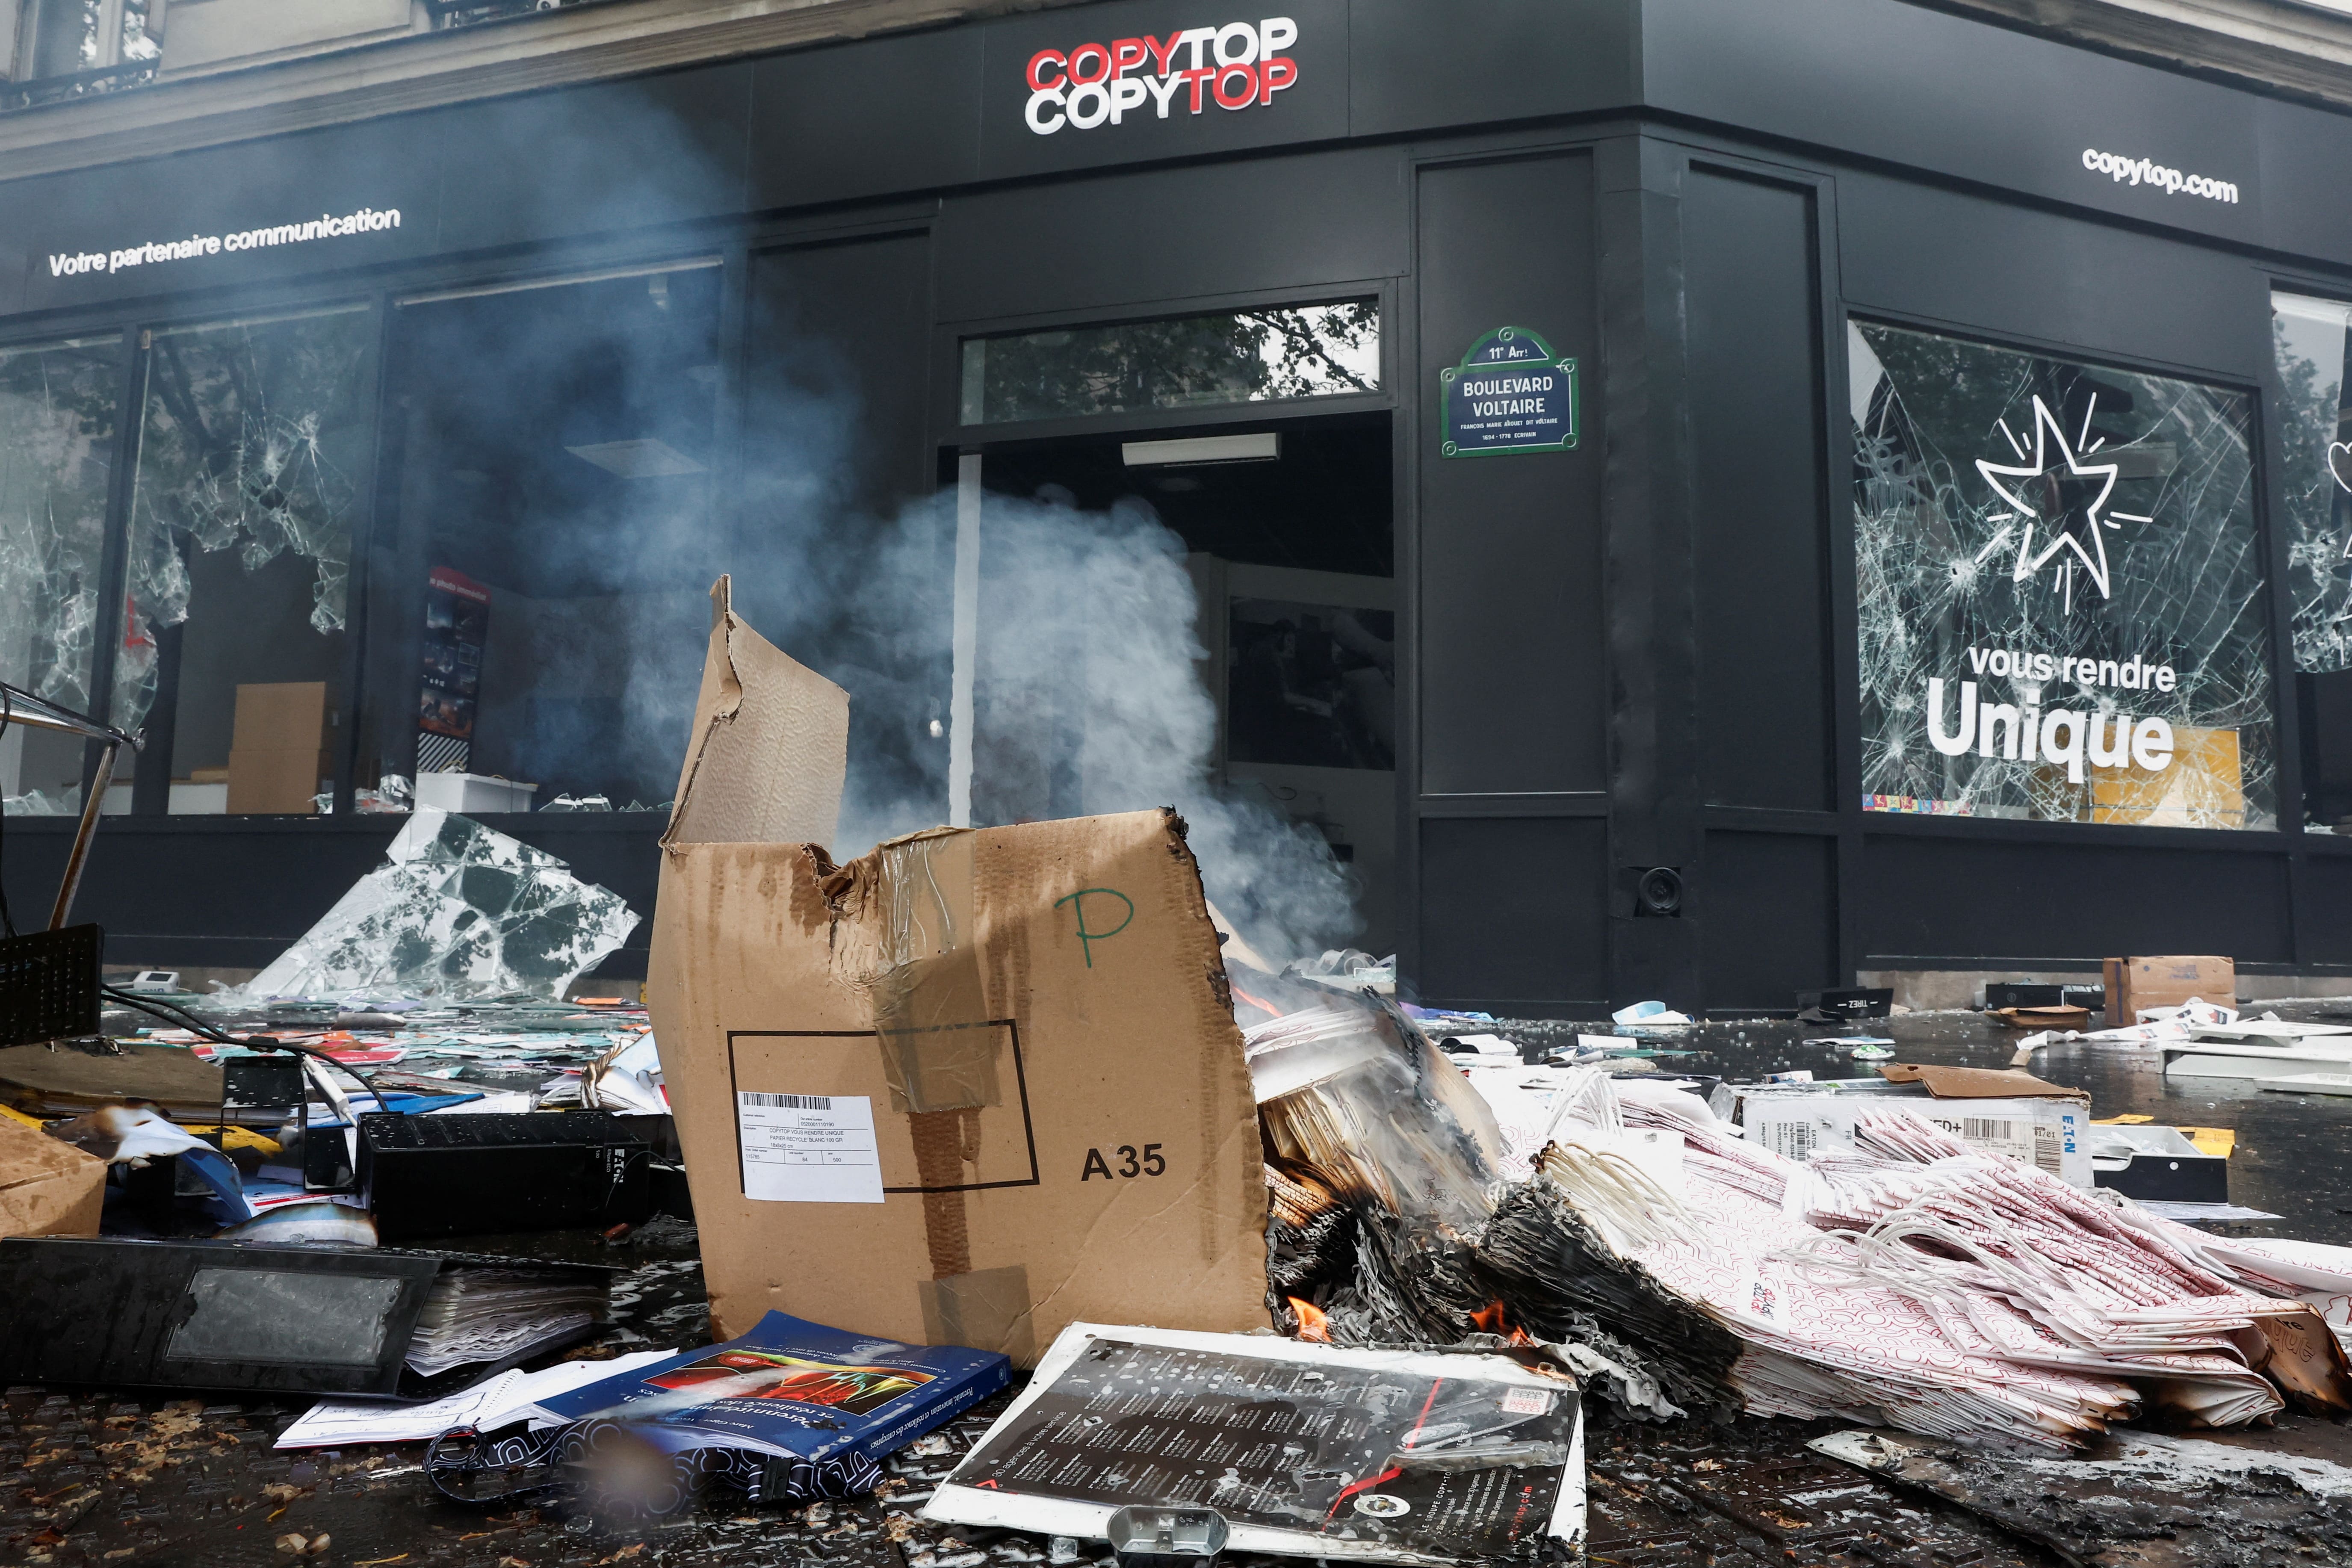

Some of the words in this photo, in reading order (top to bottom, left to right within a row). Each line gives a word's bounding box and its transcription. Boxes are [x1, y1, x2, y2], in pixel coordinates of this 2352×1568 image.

[1026, 16, 1298, 92] COPYTOP
[1025, 57, 1297, 135] COPYTOP
[2082, 148, 2239, 204] copytop.com
[50, 252, 106, 277] Votre
[109, 234, 221, 273] partenaire
[224, 207, 401, 252] communication
[1463, 376, 1553, 397] BOULEVARD
[1473, 398, 1545, 417] VOLTAIRE
[1969, 647, 2054, 679] vous
[2062, 654, 2176, 693] rendre
[1926, 677, 2174, 784] Unique
[1054, 888, 1134, 969] P
[1848, 1000, 1868, 1008] TIREZ
[1845, 1131, 1852, 1140] FR
[745, 1401, 816, 1414] résilience
[931, 1397, 953, 1413] innovation
[904, 1414, 924, 1429] résilience
[870, 1430, 895, 1450] entreprises
[990, 1469, 1007, 1477] 30
[1001, 1446, 1032, 1469] agences
[1029, 1428, 1050, 1442] votre
[1043, 1411, 1068, 1429] service
[1435, 1471, 1452, 1498] COPY-TO
[1424, 1500, 1441, 1522] GROUPE
[1421, 1524, 1430, 1533] LE
